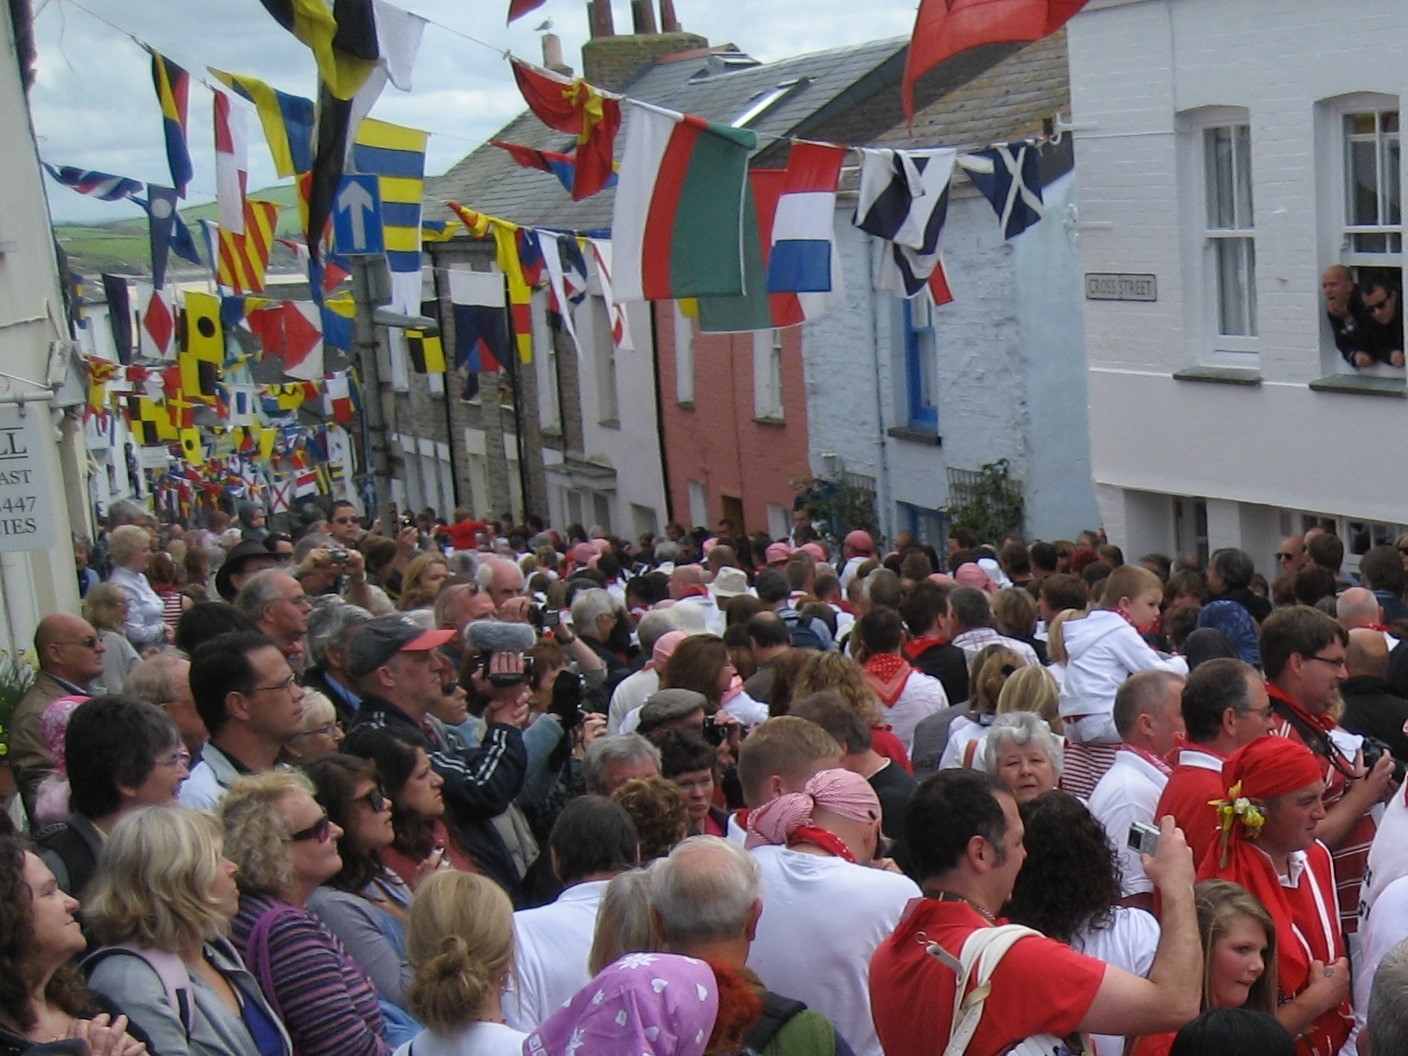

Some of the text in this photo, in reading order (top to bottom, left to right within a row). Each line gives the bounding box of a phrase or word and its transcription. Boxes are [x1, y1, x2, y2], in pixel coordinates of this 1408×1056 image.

[1118, 279, 1153, 297] STREET
[0, 496, 37, 513] 447
[0, 517, 37, 535] IES
